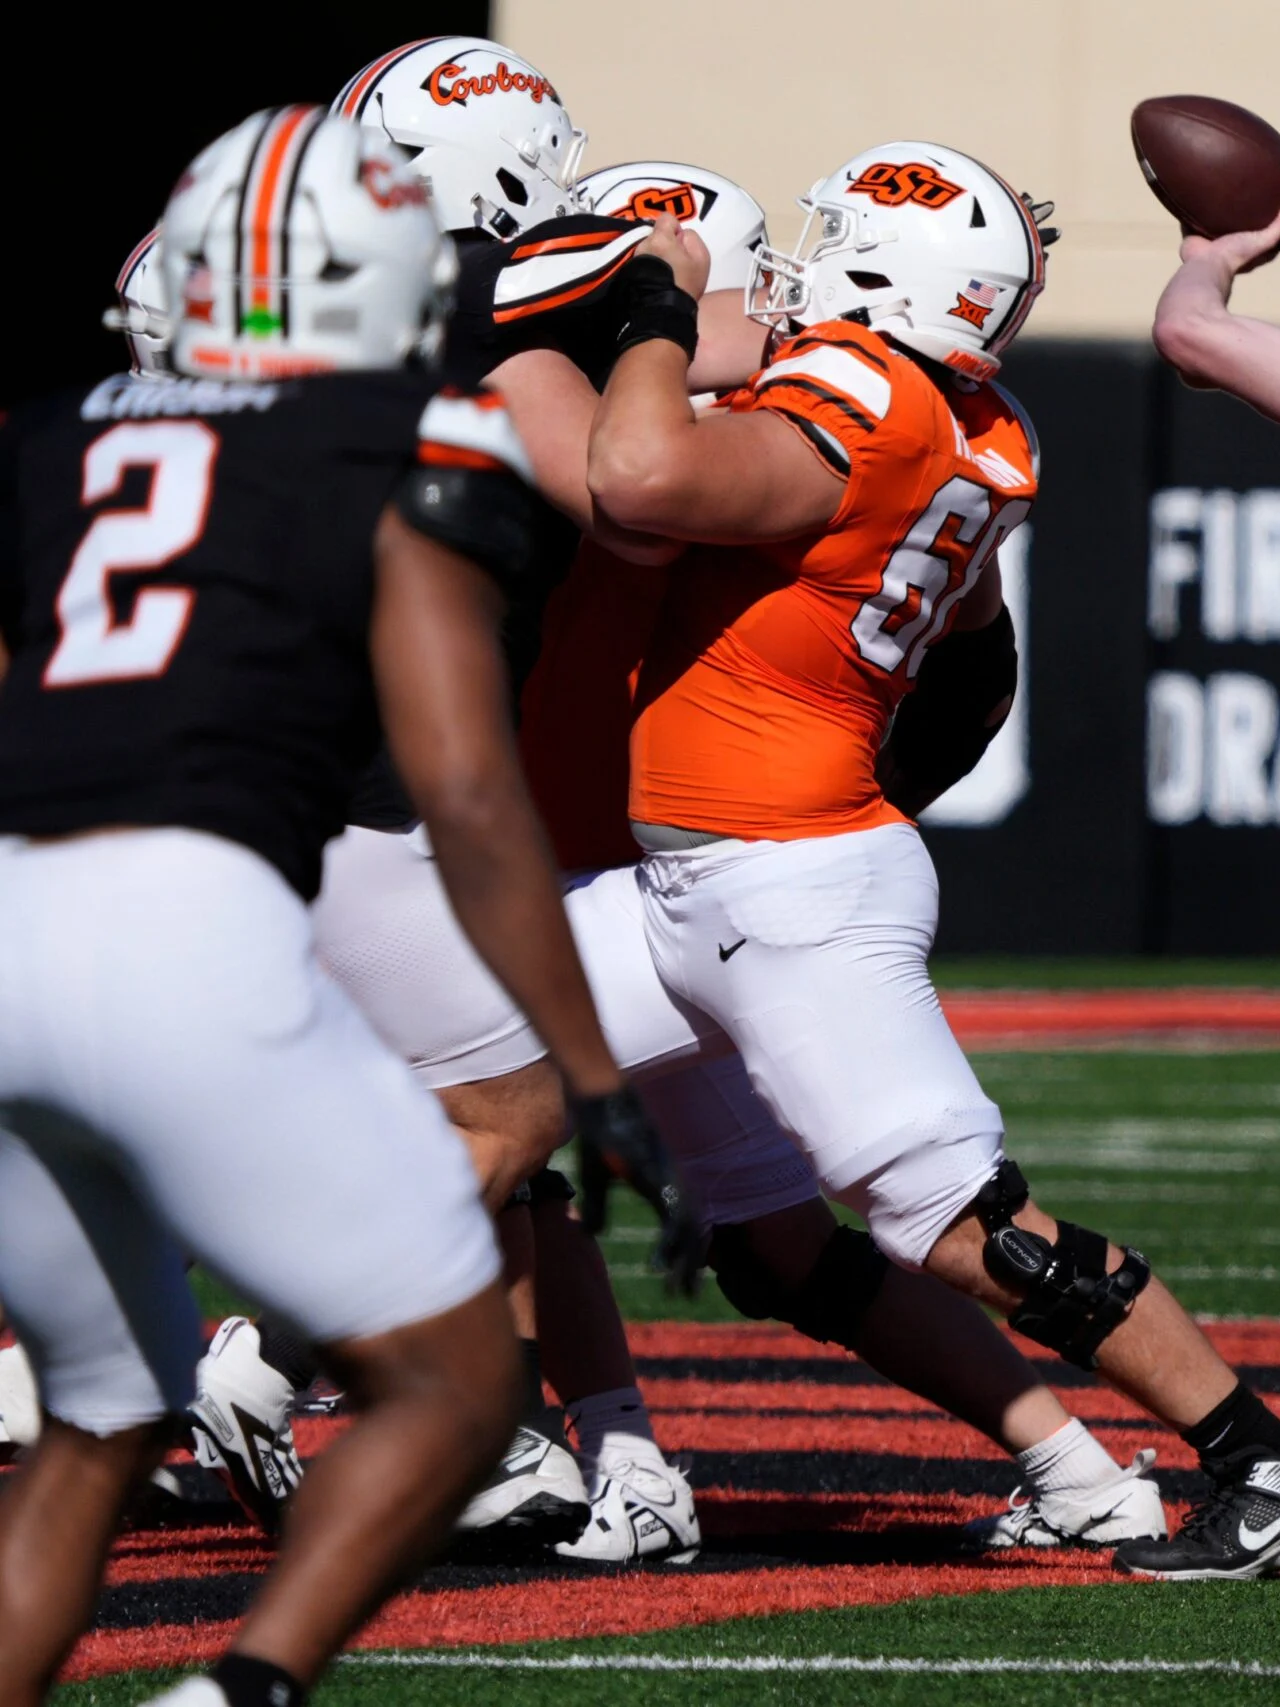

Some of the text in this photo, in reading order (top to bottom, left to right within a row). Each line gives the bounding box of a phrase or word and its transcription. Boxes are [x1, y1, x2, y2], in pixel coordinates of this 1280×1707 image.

[608, 183, 698, 223] SU
[846, 162, 967, 211] OSU
[40, 418, 222, 692] 2
[1001, 1235, 1038, 1268] DONJOY
